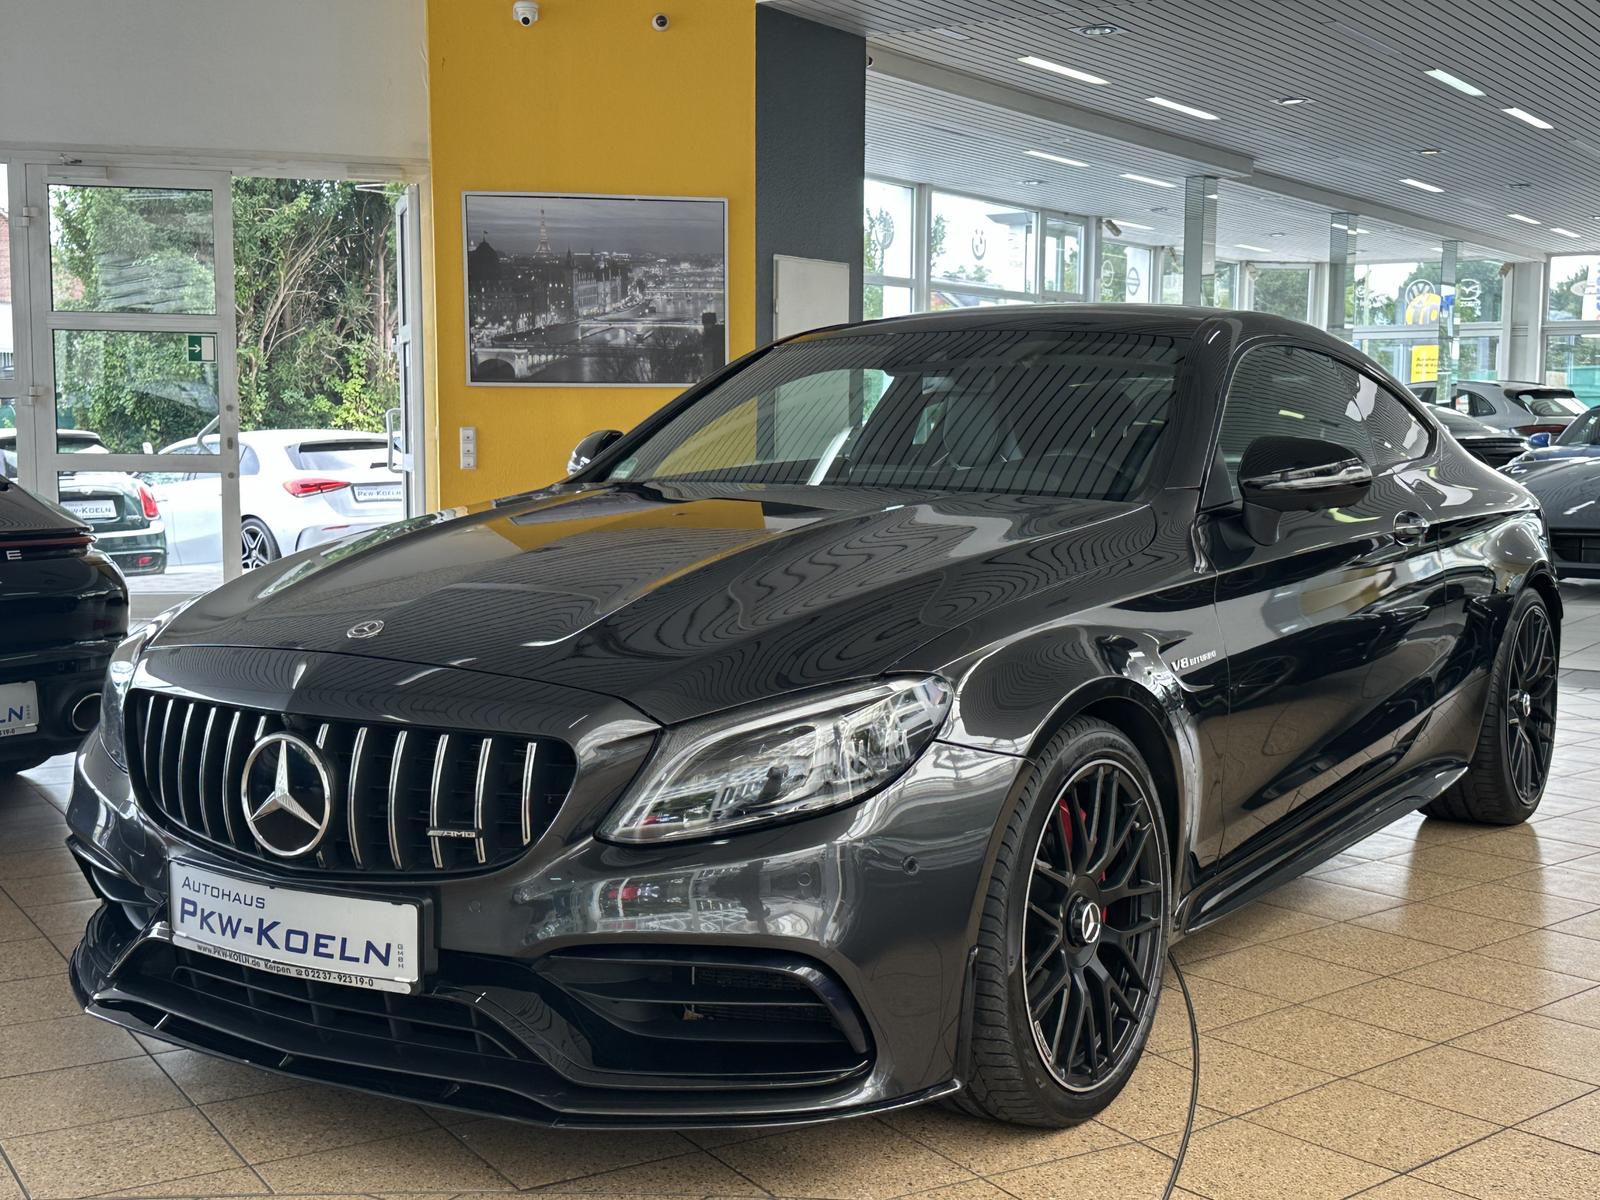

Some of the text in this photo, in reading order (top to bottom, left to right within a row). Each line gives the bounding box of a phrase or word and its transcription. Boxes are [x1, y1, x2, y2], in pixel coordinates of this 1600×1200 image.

[1170, 657, 1189, 672] V8
[442, 830, 476, 838] AMG
[181, 876, 266, 909] AUTOHAUS
[180, 897, 392, 967] PKW-KOELN
